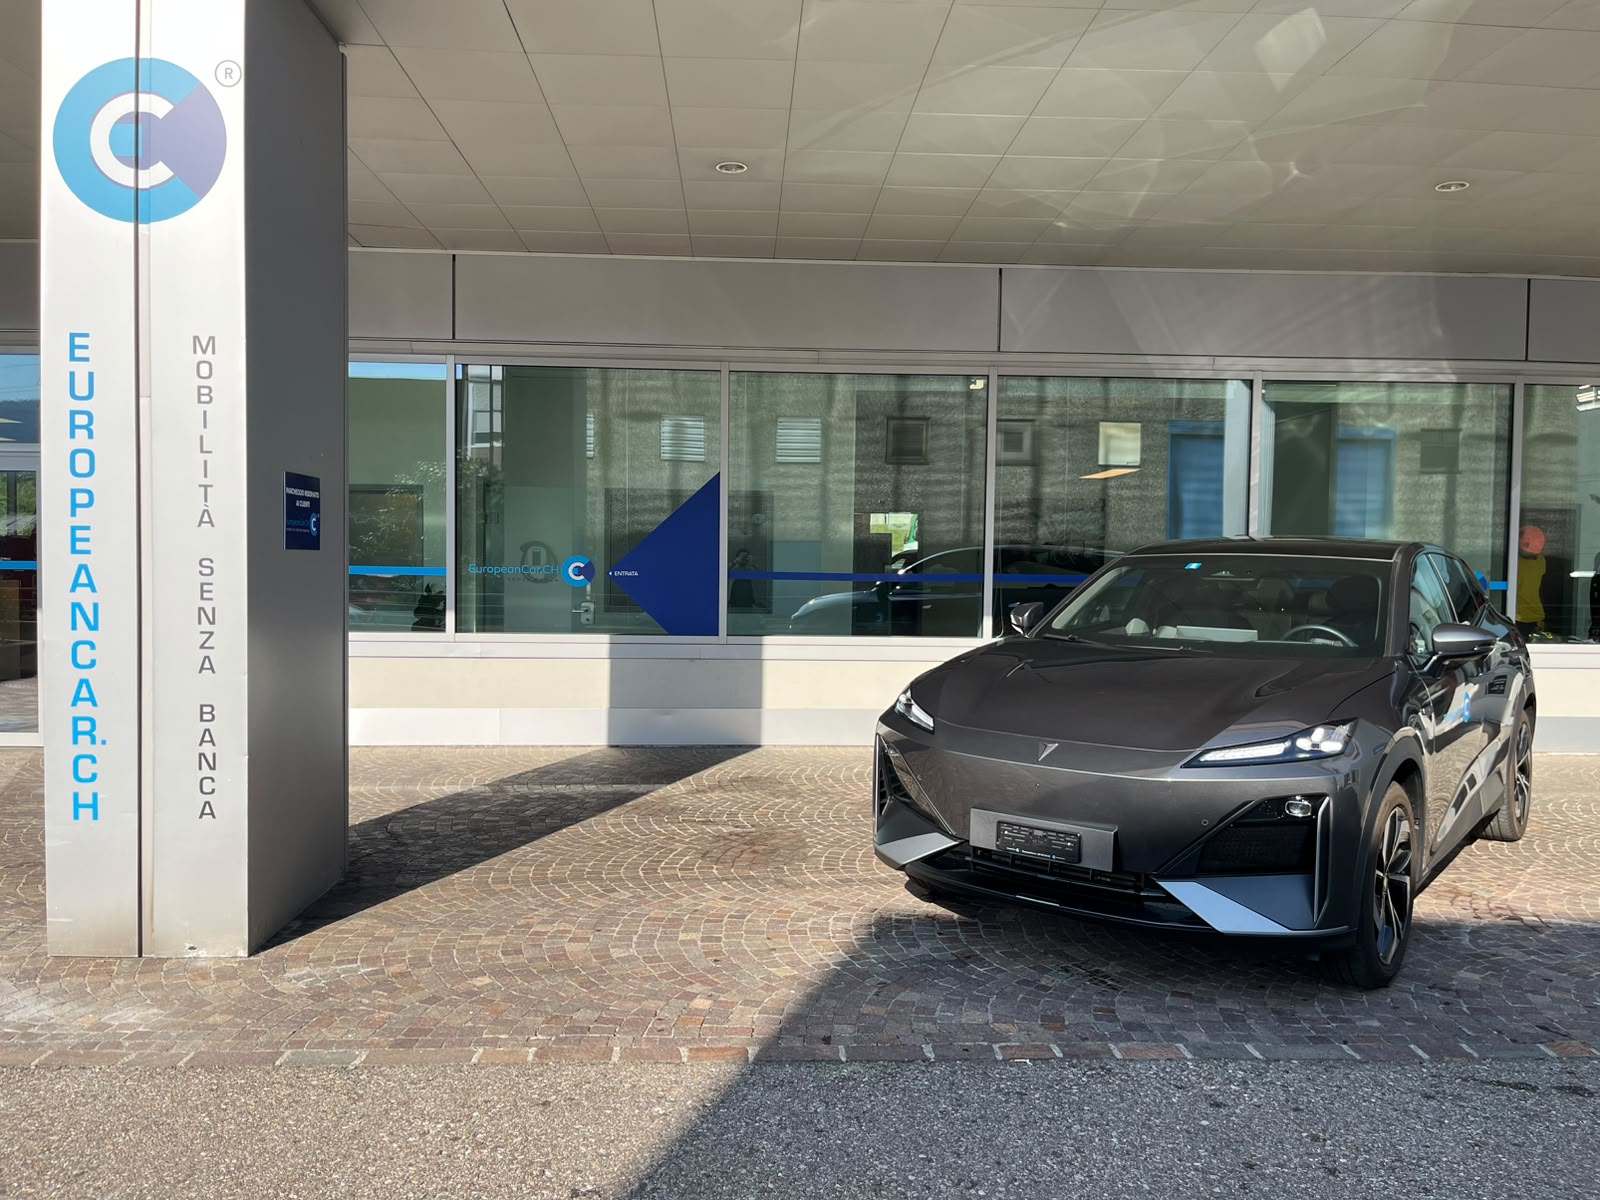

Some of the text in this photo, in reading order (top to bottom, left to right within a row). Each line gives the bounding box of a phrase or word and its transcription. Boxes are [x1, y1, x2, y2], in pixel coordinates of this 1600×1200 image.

[69, 332, 107, 822] EUROPEANCAR.CH
[192, 335, 217, 820] MOBILITÀ SENZA BANCA
[468, 563, 560, 576] EuropeanCar.CH
